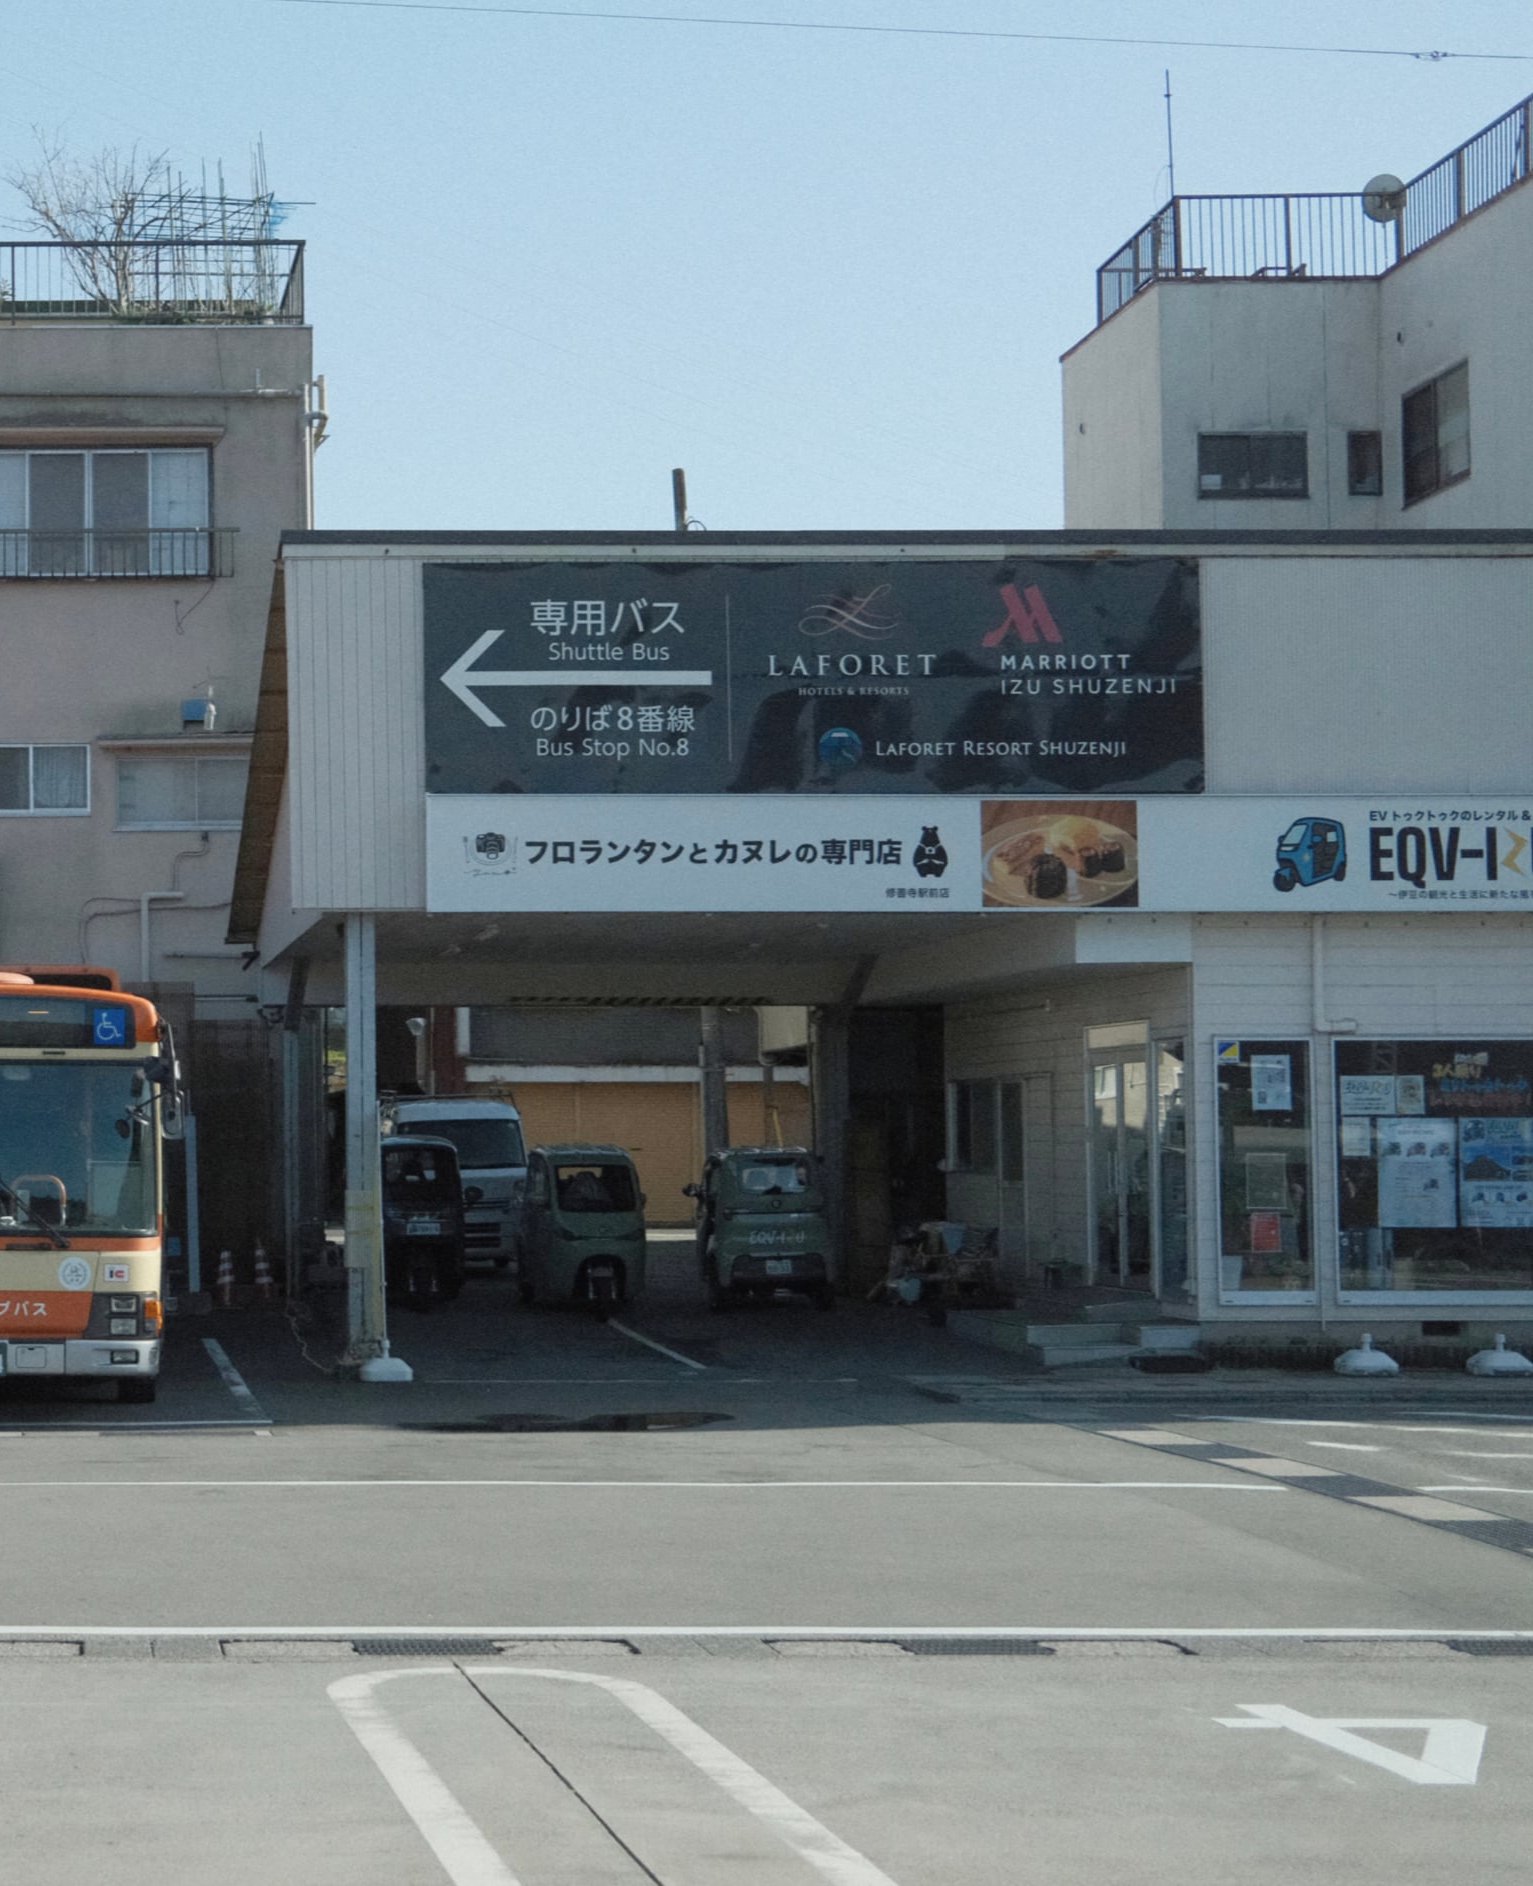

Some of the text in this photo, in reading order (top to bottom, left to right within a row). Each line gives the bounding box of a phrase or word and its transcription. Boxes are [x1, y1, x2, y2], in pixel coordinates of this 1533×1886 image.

[530, 598, 685, 636] 専用バス
[548, 642, 670, 661] Shuttle Bus
[768, 654, 937, 676] LAFORET
[1001, 654, 1131, 670] MARRIOTT
[798, 686, 843, 696] HOTELS
[859, 686, 910, 695] RESORTS
[1001, 678, 1176, 694] IZU SHUZENJI
[530, 705, 696, 733] のりば8番線
[537, 738, 689, 761] Bus Stop No.8
[963, 740, 1034, 756] RESORT
[1039, 739, 1127, 757] SHUZENJI
[524, 838, 903, 865] フロランタンとカヌレの専門店
